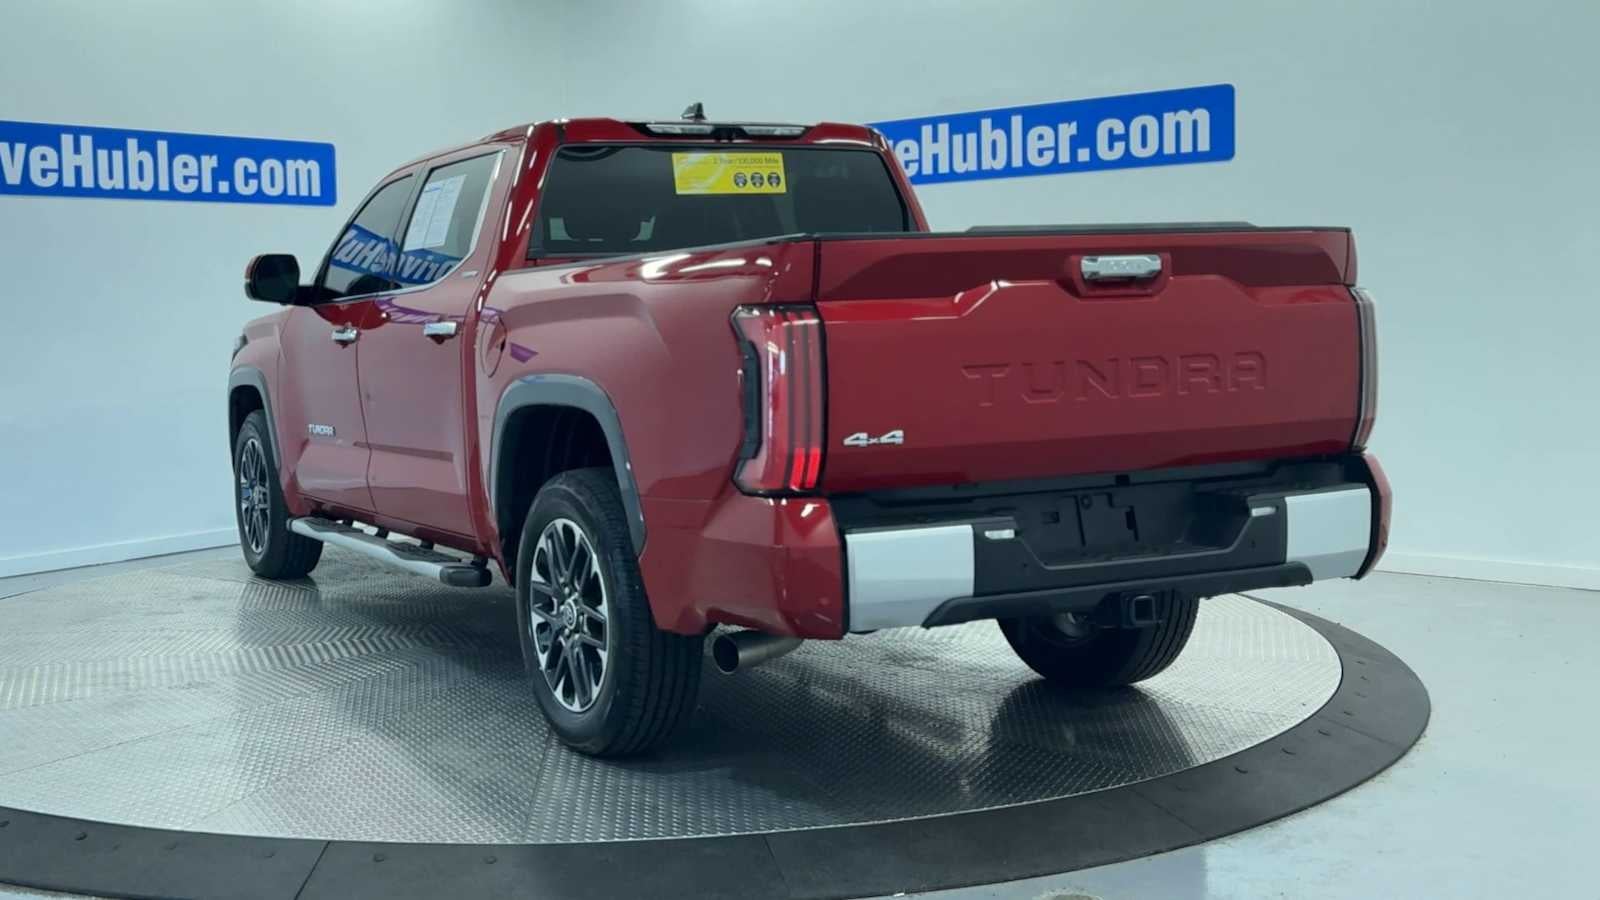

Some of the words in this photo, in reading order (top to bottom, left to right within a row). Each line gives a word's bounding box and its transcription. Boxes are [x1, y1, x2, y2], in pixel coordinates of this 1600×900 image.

[0, 133, 321, 197] veHubler.com
[887, 107, 1210, 177] eHubler.com
[961, 351, 1267, 407] TUNDRA
